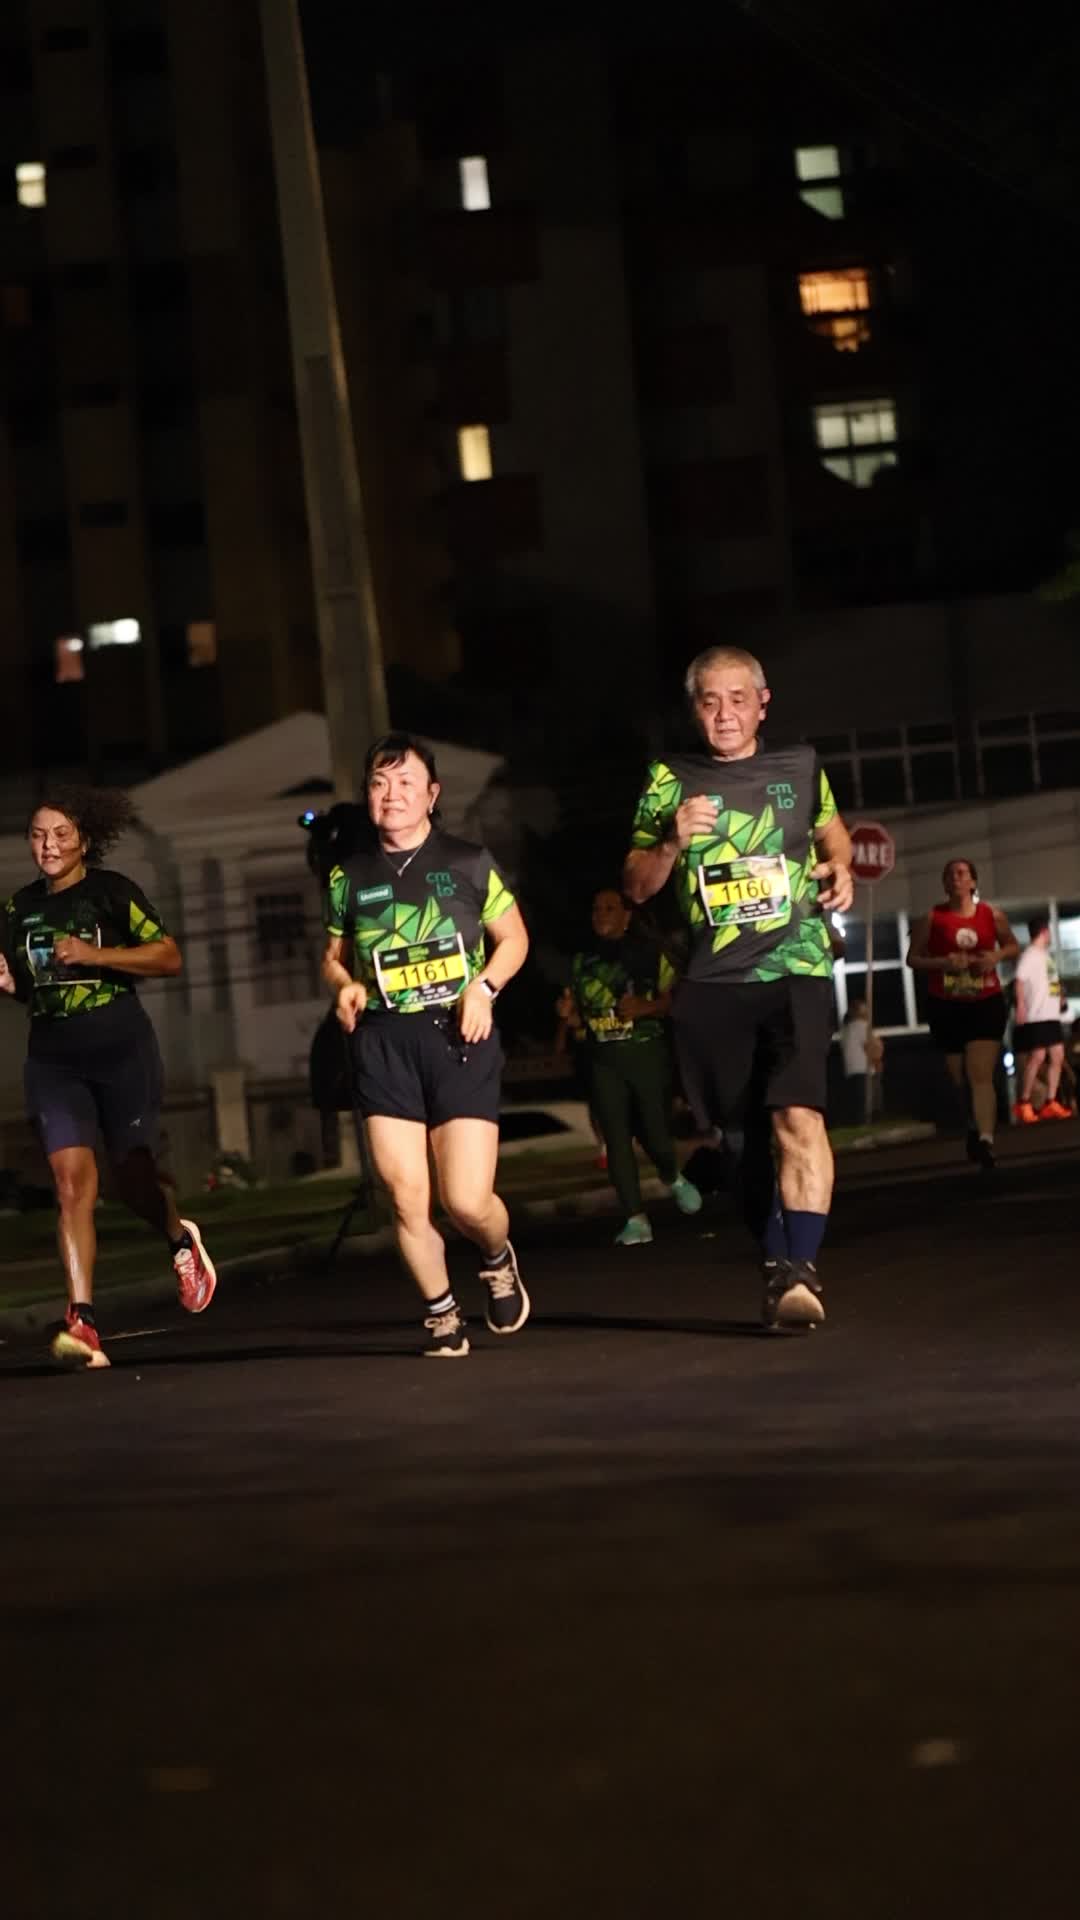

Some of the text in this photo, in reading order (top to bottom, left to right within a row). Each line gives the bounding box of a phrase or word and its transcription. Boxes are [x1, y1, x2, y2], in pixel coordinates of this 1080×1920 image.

[766, 783, 792, 795] cm
[425, 872, 452, 883] cm
[721, 878, 772, 903] 1160
[399, 960, 449, 987] 1161
